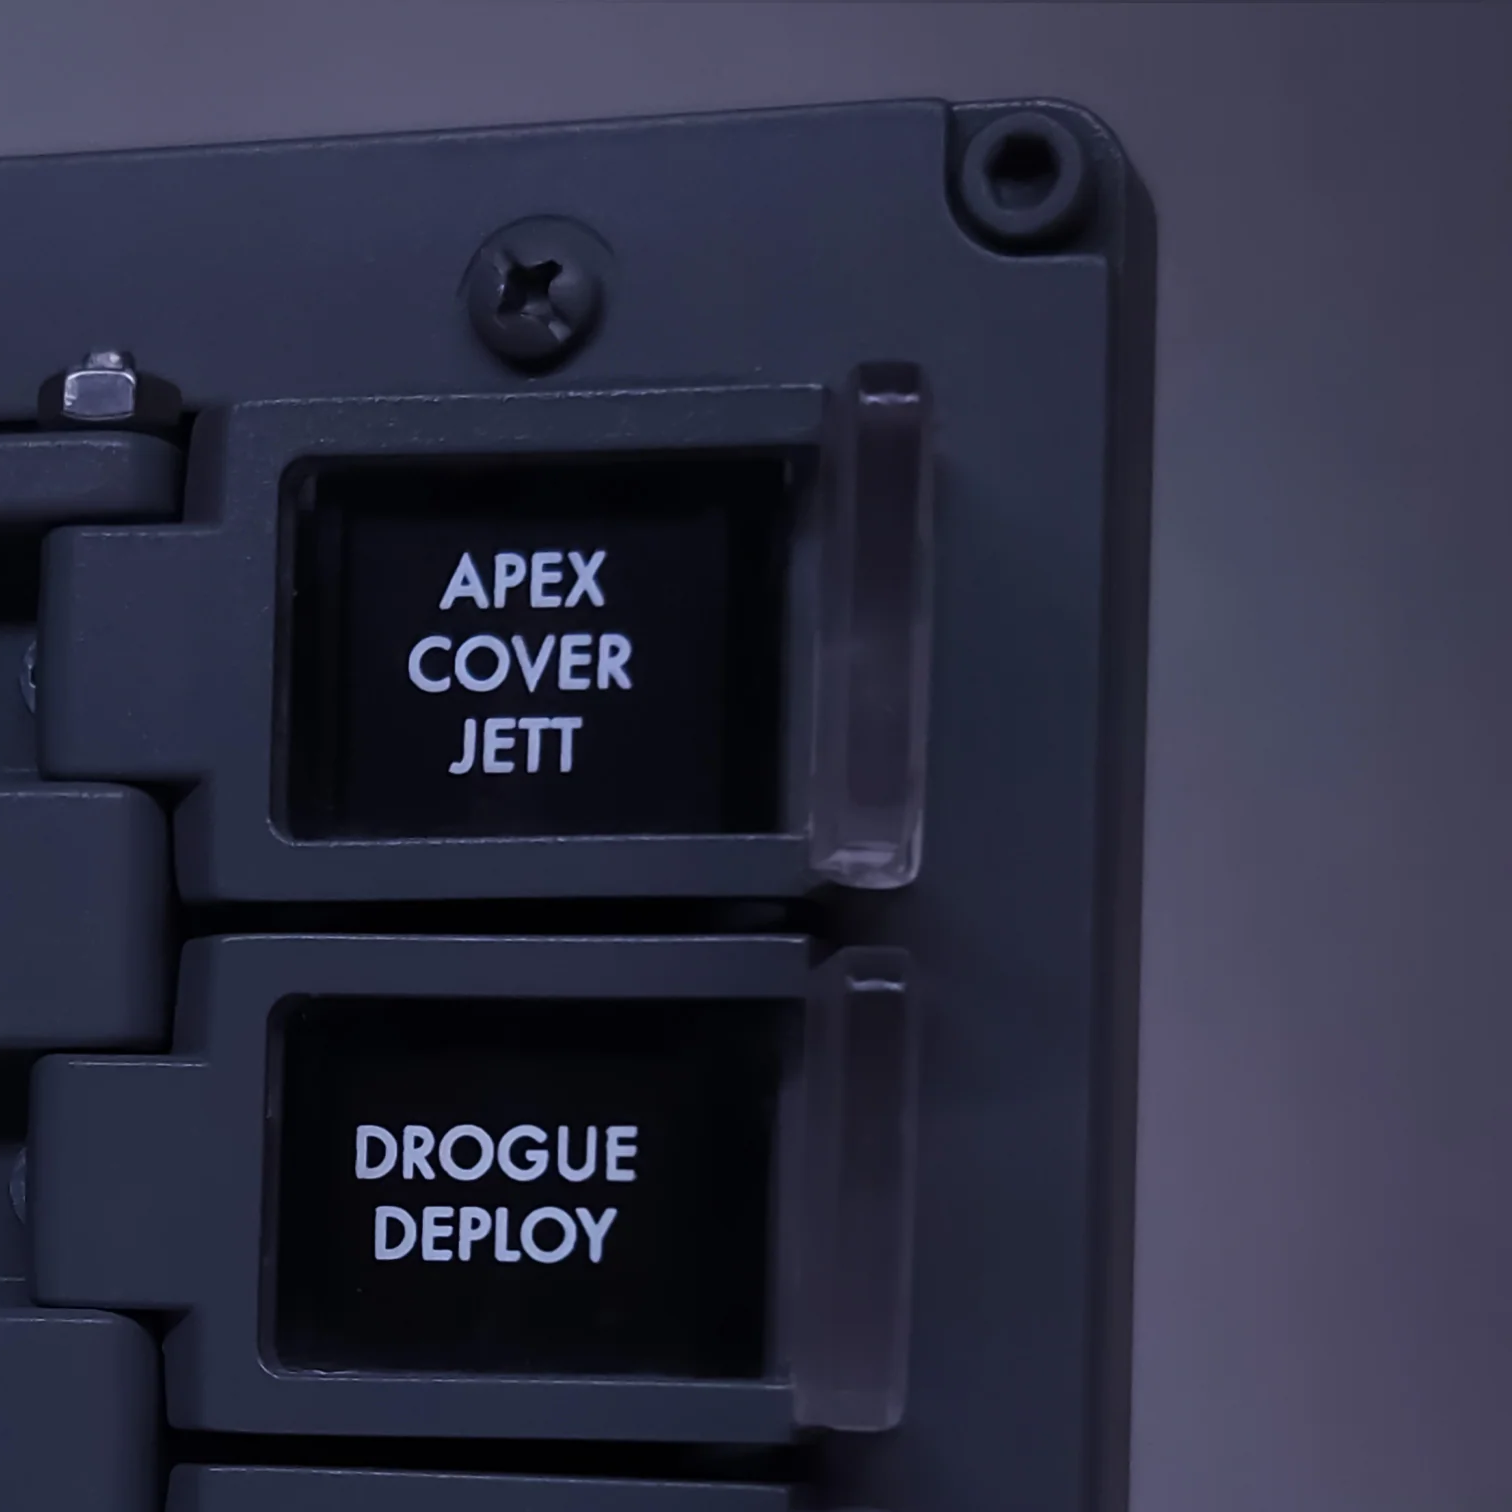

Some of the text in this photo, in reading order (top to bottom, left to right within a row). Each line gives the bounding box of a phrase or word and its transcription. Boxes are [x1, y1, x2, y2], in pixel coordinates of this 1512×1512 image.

[439, 550, 606, 610] APEX
[408, 633, 632, 693] COVER
[448, 716, 583, 775] JETT
[355, 1124, 638, 1182] DROGUE
[374, 1205, 618, 1264] DEPLOY
